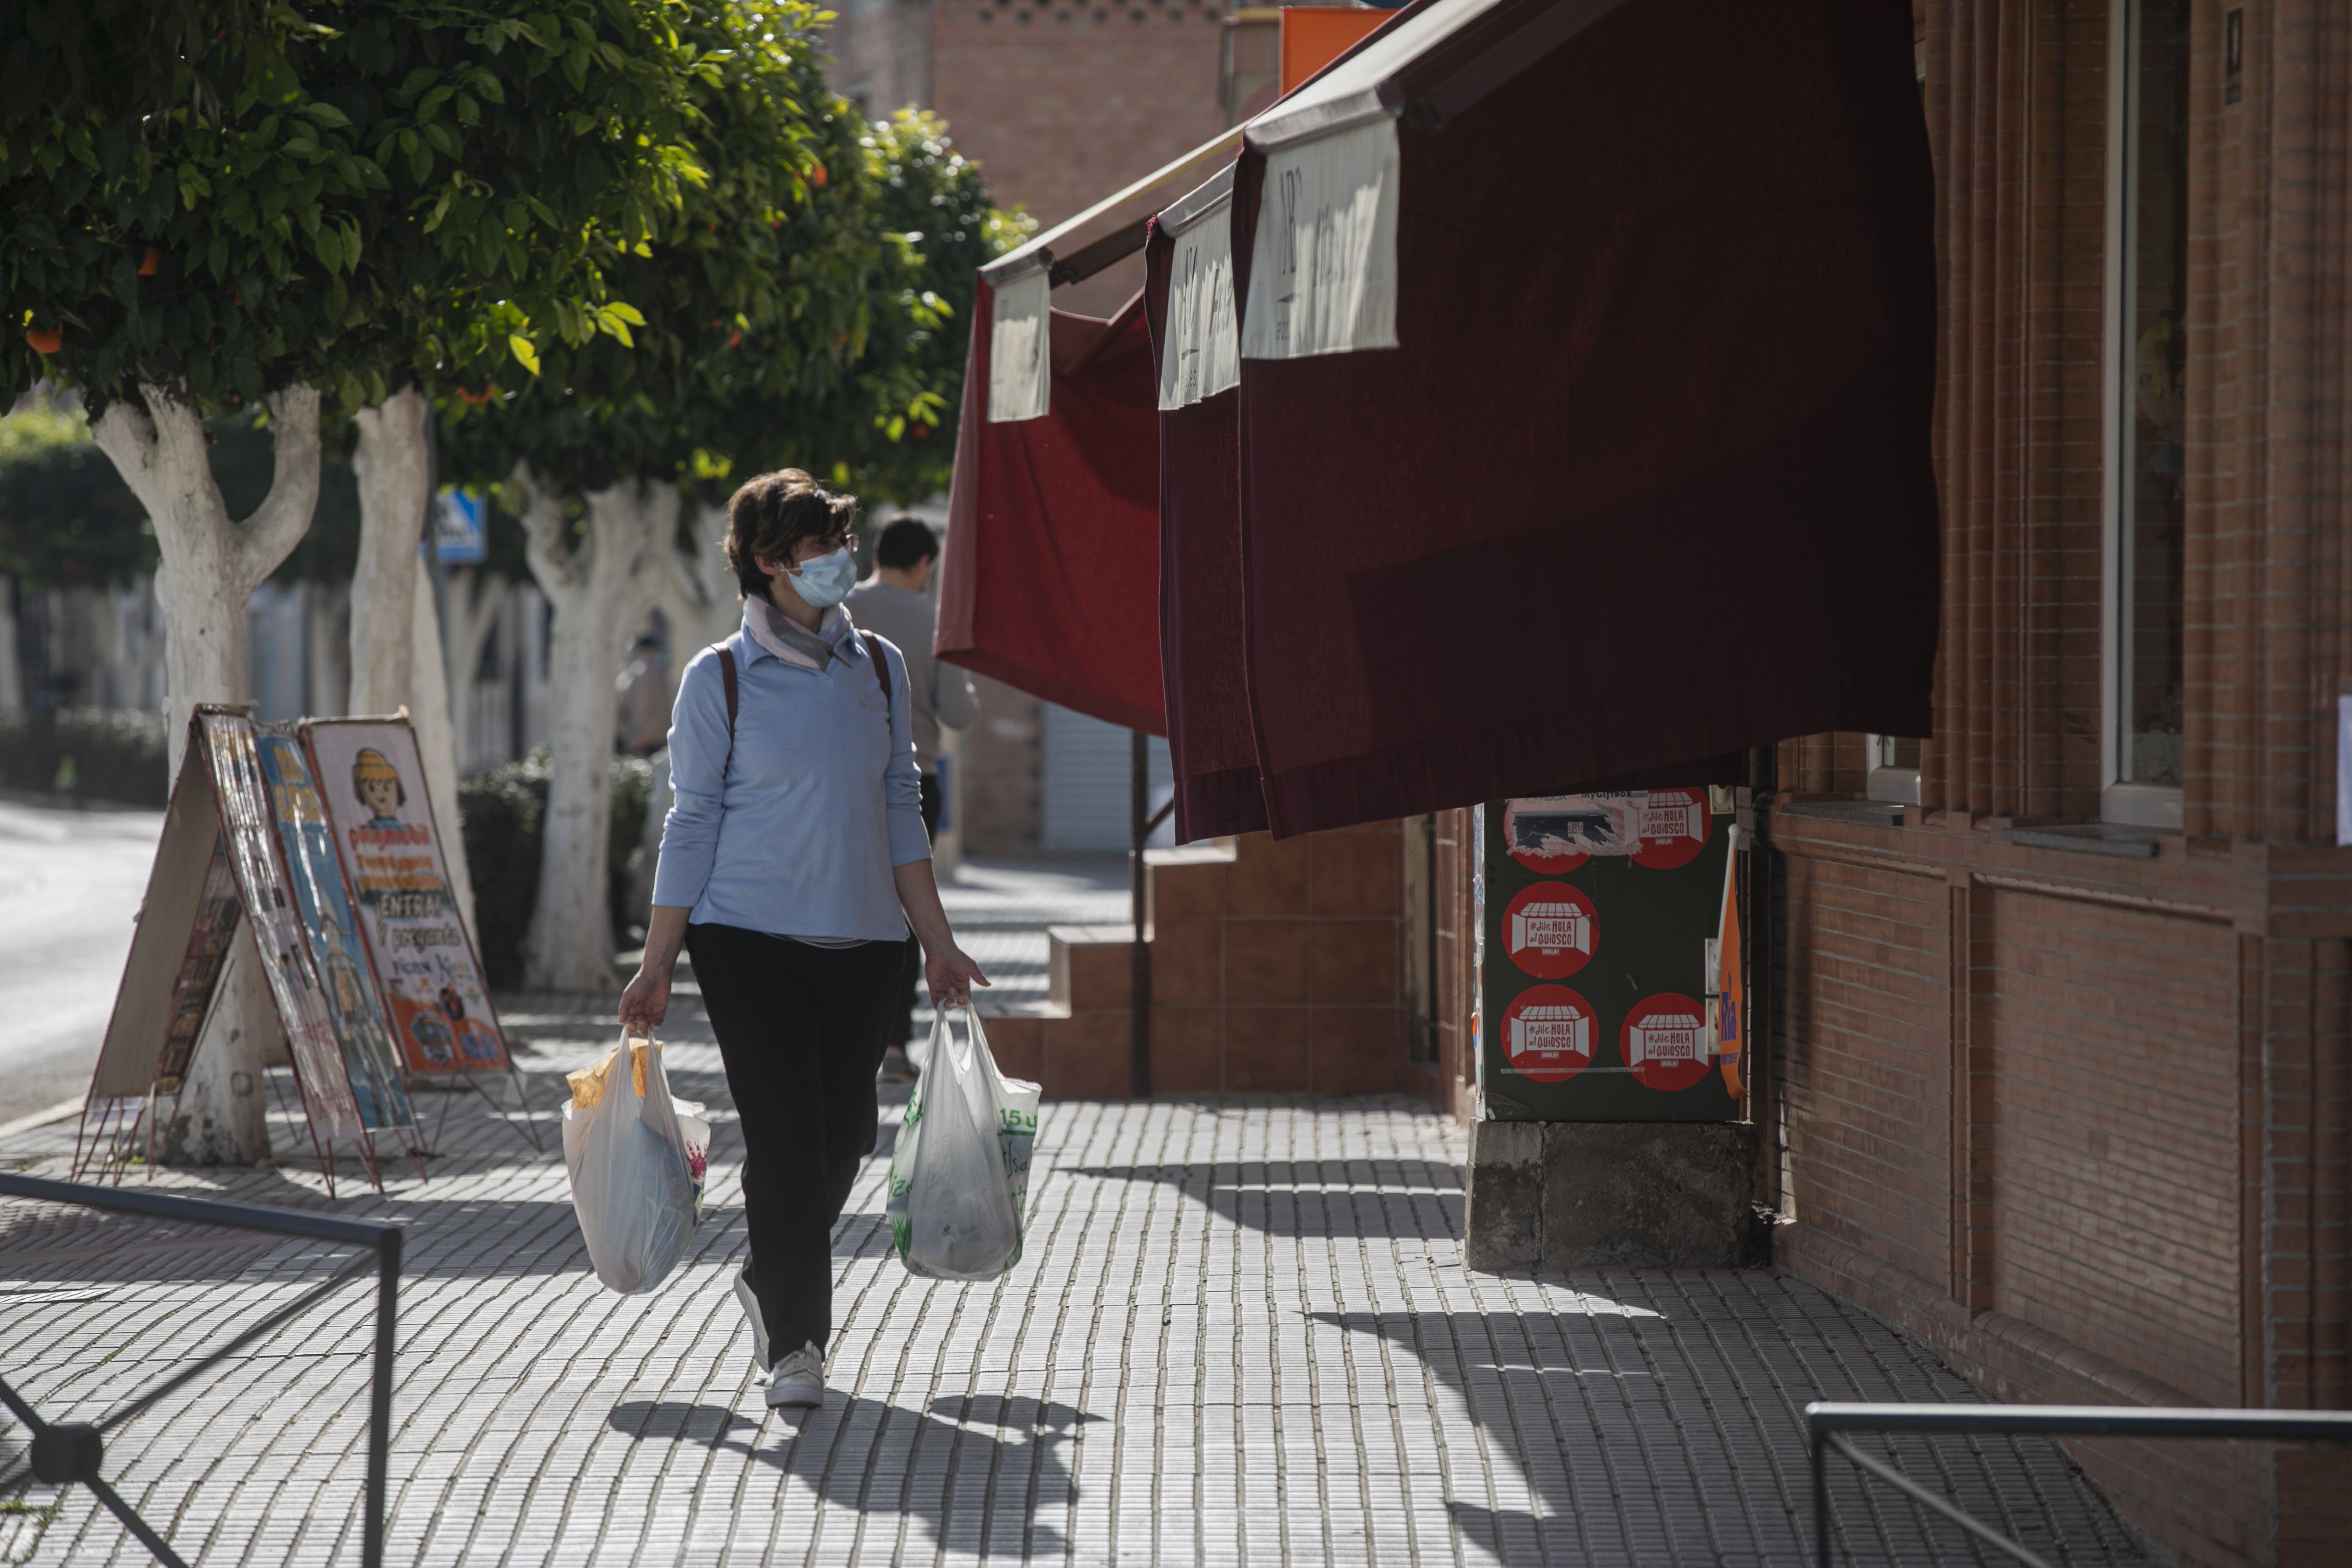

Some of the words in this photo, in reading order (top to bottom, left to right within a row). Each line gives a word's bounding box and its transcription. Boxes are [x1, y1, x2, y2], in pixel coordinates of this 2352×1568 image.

[1664, 810, 1683, 822] HOLA
[1642, 824, 1650, 833] al
[1552, 921, 1571, 932] HOLA
[1530, 933, 1537, 942] al
[1551, 1024, 1570, 1035] HOLA
[1528, 1036, 1536, 1045] al
[1670, 1033, 1690, 1044] HOLA
[1648, 1045, 1656, 1055] al
[1000, 1108, 1022, 1127] 15
